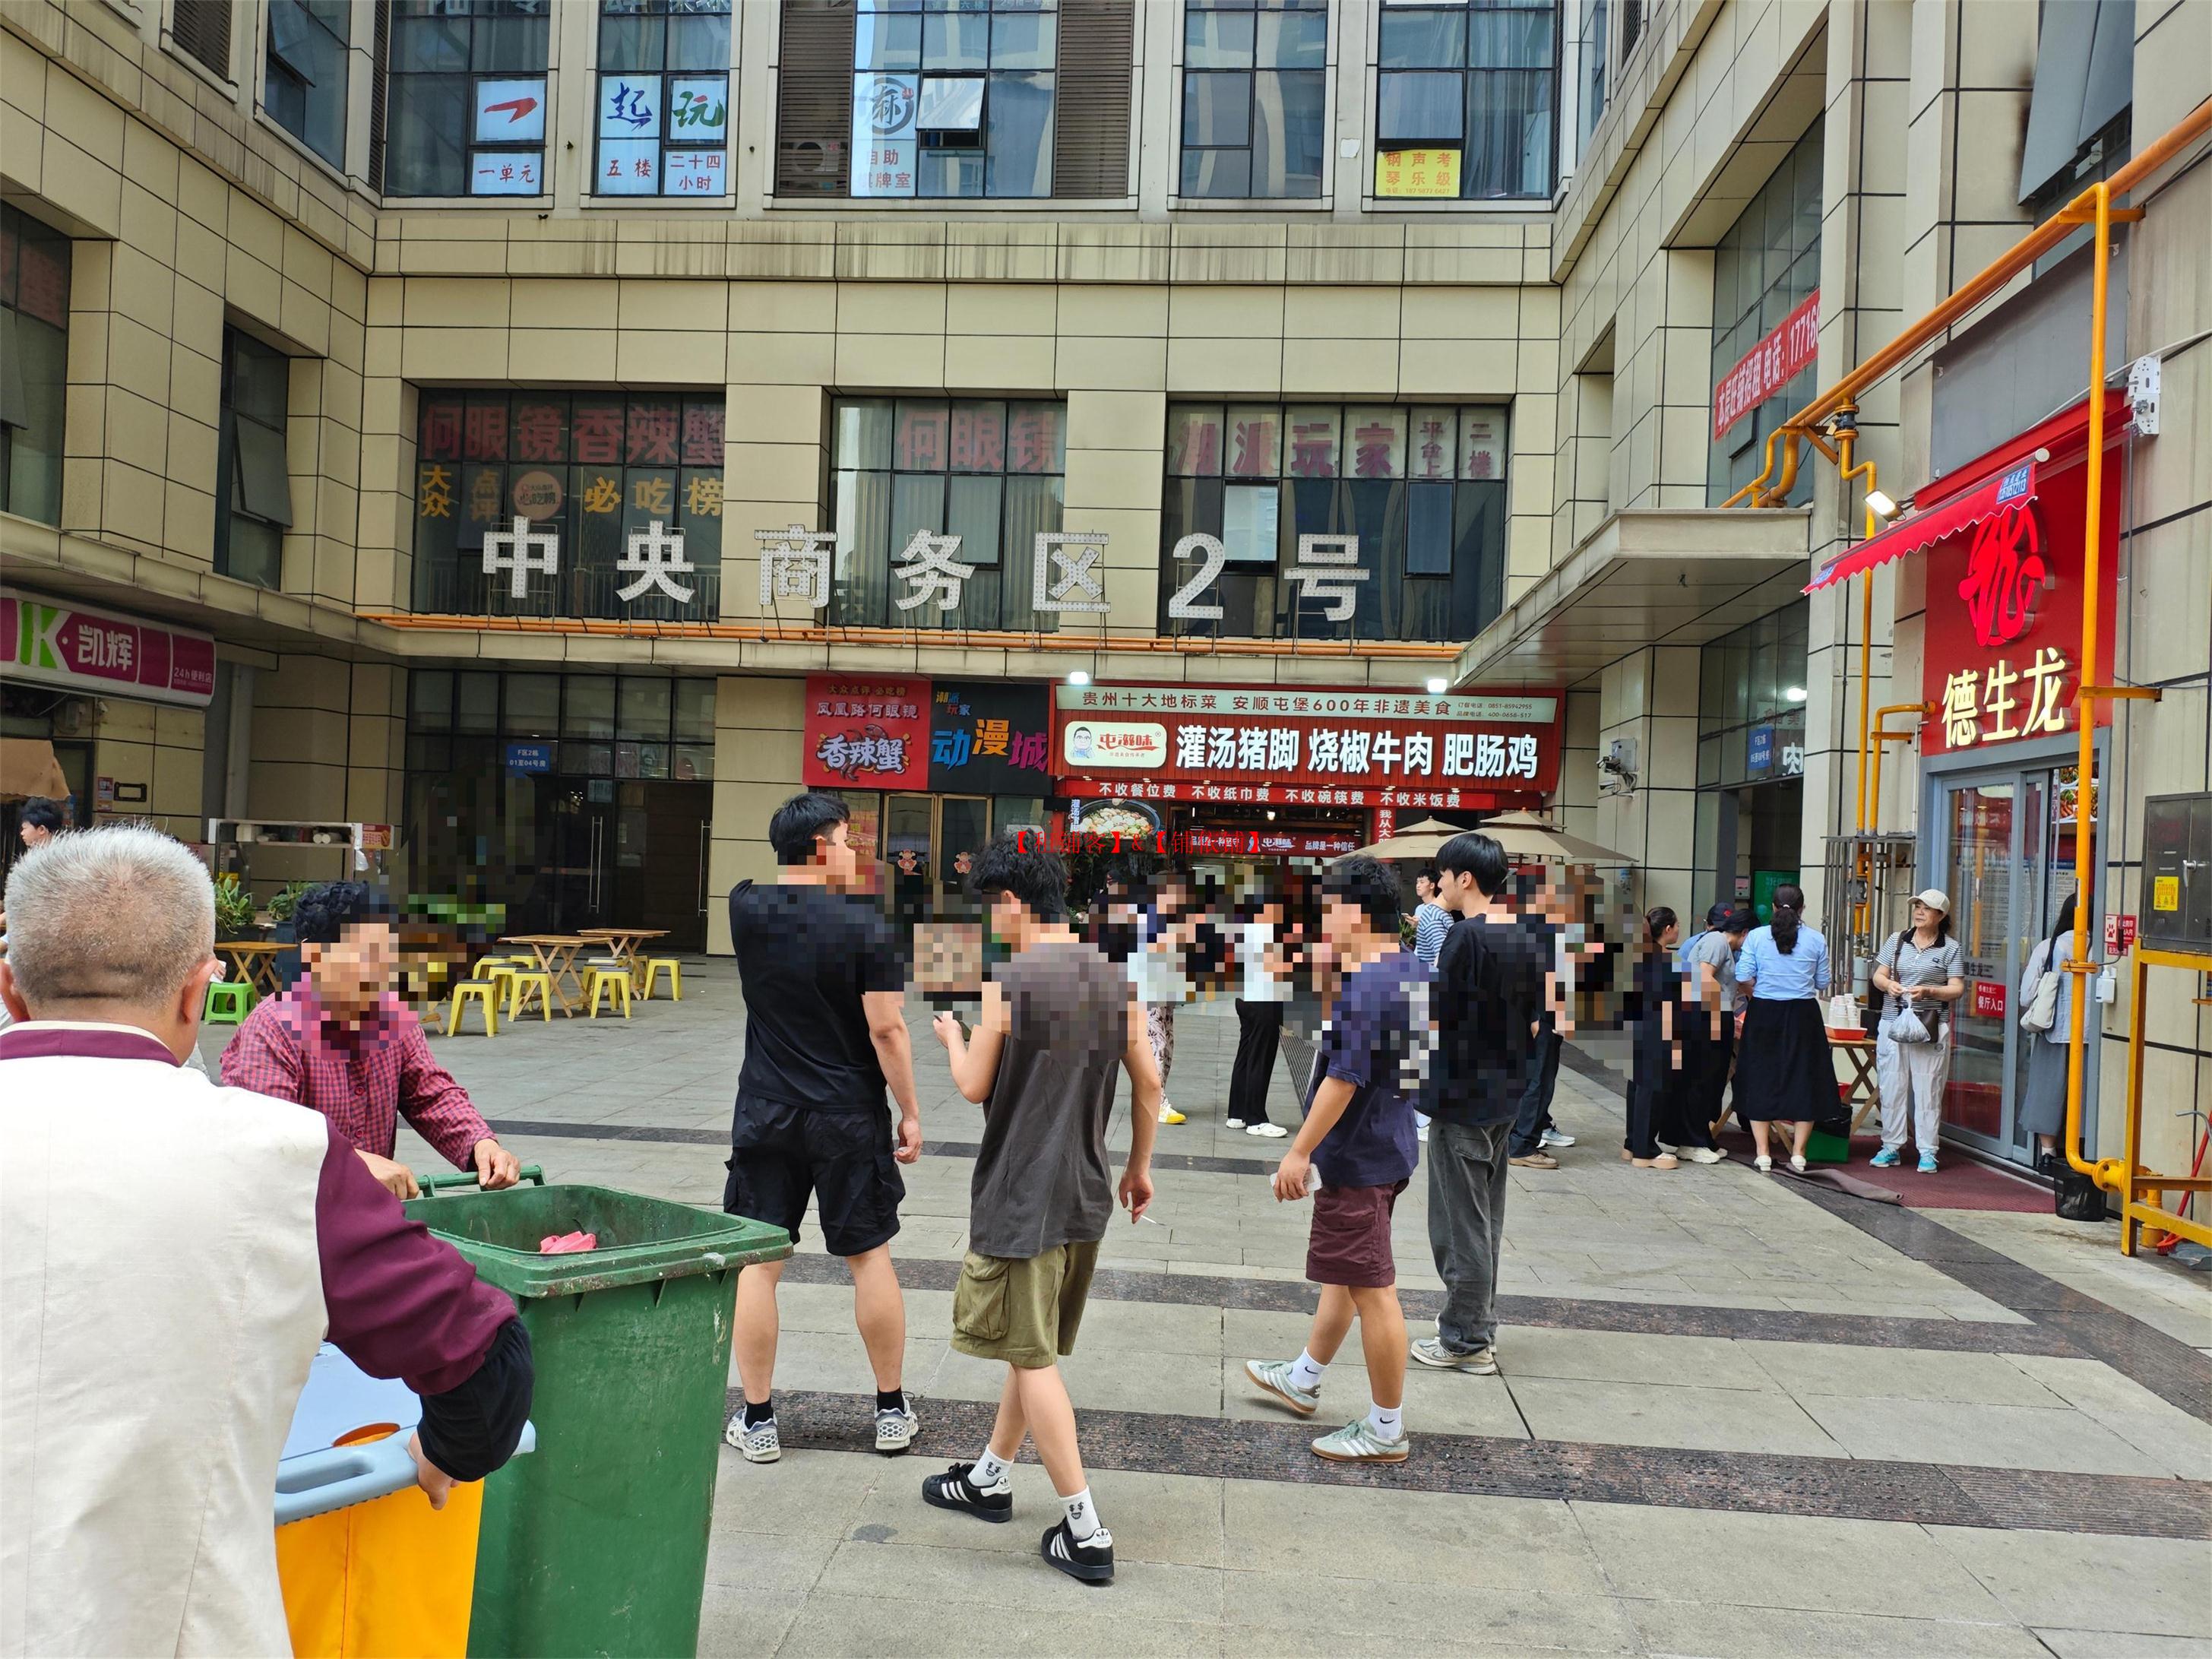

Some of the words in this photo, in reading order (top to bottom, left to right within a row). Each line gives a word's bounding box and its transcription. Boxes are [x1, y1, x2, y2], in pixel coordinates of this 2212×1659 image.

[478, 165, 535, 184] 一单元
[606, 159, 652, 178] 五楼
[670, 154, 720, 170] 二十四
[679, 175, 712, 192] 小时
[421, 464, 451, 519] 大众
[584, 476, 724, 518] 必吃榜
[483, 515, 1370, 622] 中央商务区2号
[78, 624, 134, 672] 凯辉
[1082, 691, 1217, 710] 贵州十大地标菜
[1233, 695, 1452, 716] 安顺屯堡600年非遗美食
[1941, 646, 2067, 749] 德生龙
[818, 734, 905, 773] 香辣蟹
[932, 718, 1048, 772] 动漫城
[1176, 724, 1300, 772] 灌汤猪脚
[1307, 727, 1434, 777] 烧椒牛肉
[1441, 733, 1538, 780] 肥肠鸡
[1099, 782, 1177, 798] 不收餐位费
[1191, 785, 1271, 803] 不收纸巾费
[1285, 788, 1364, 806] 不收碗筷费
[1380, 792, 1460, 808] 不收米饭费
[1305, 840, 1356, 852] 品牌是一种信任
[1978, 996, 2003, 1012] 餐厅入口
